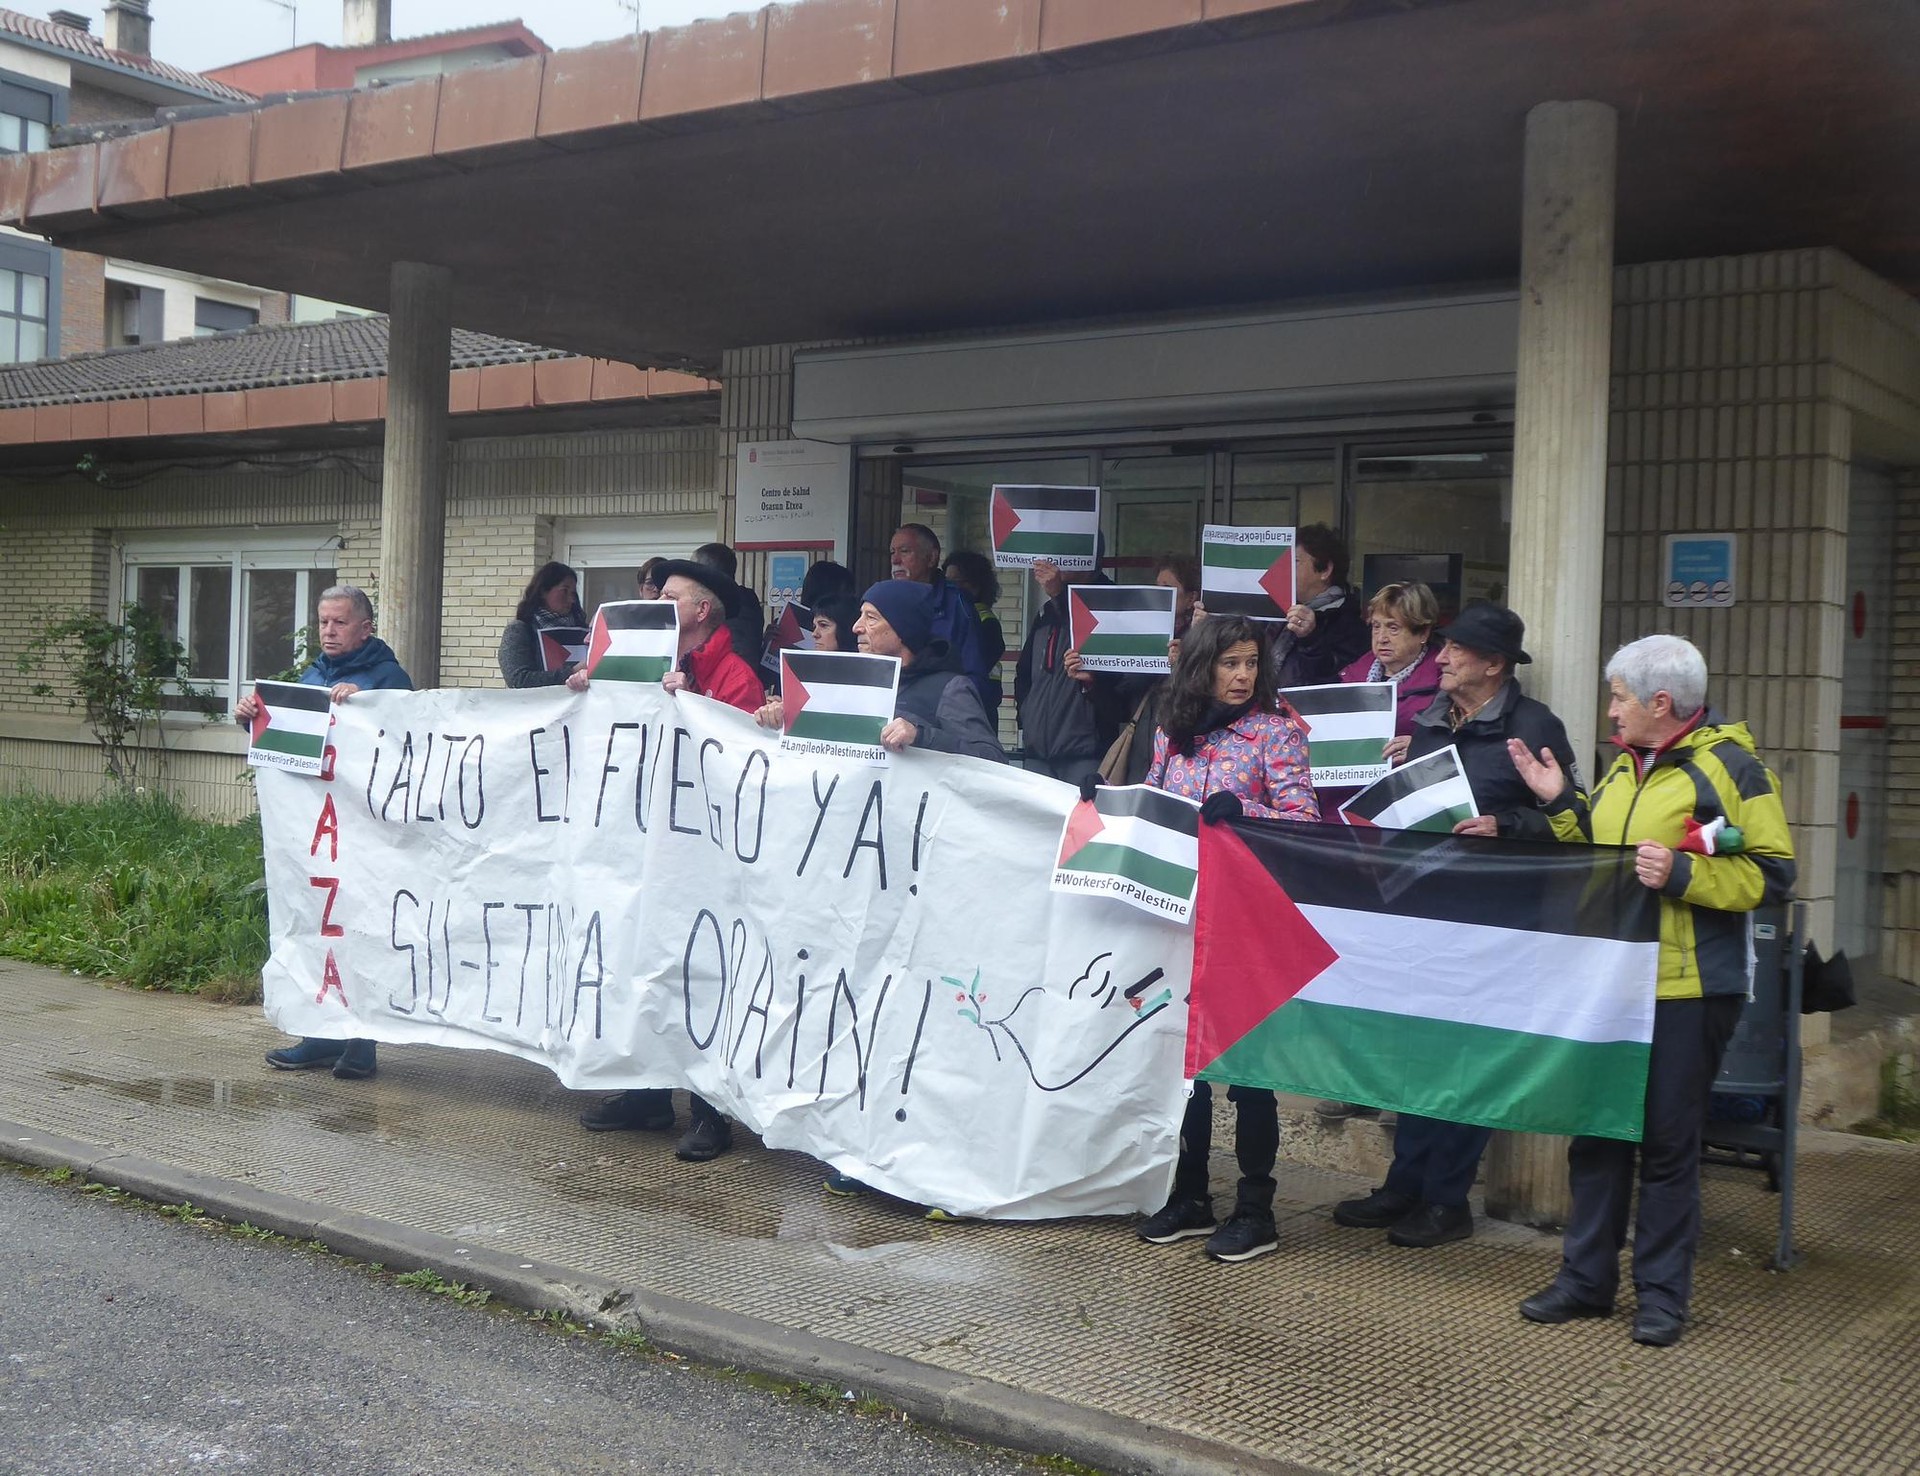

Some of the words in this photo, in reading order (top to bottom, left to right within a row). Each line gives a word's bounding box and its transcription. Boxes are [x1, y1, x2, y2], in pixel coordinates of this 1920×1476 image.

[761, 488, 781, 497] Centro
[783, 487, 791, 497] de
[792, 486, 810, 496] Salud
[761, 501, 784, 511] Osasun
[785, 500, 803, 510] Etxea
[1081, 657, 1171, 669] WorkersForPalestine
[780, 739, 887, 761] #LangileokPalestinarekin
[594, 722, 771, 864] FUEGO
[1054, 872, 1187, 916] #WorkersForPalestine
